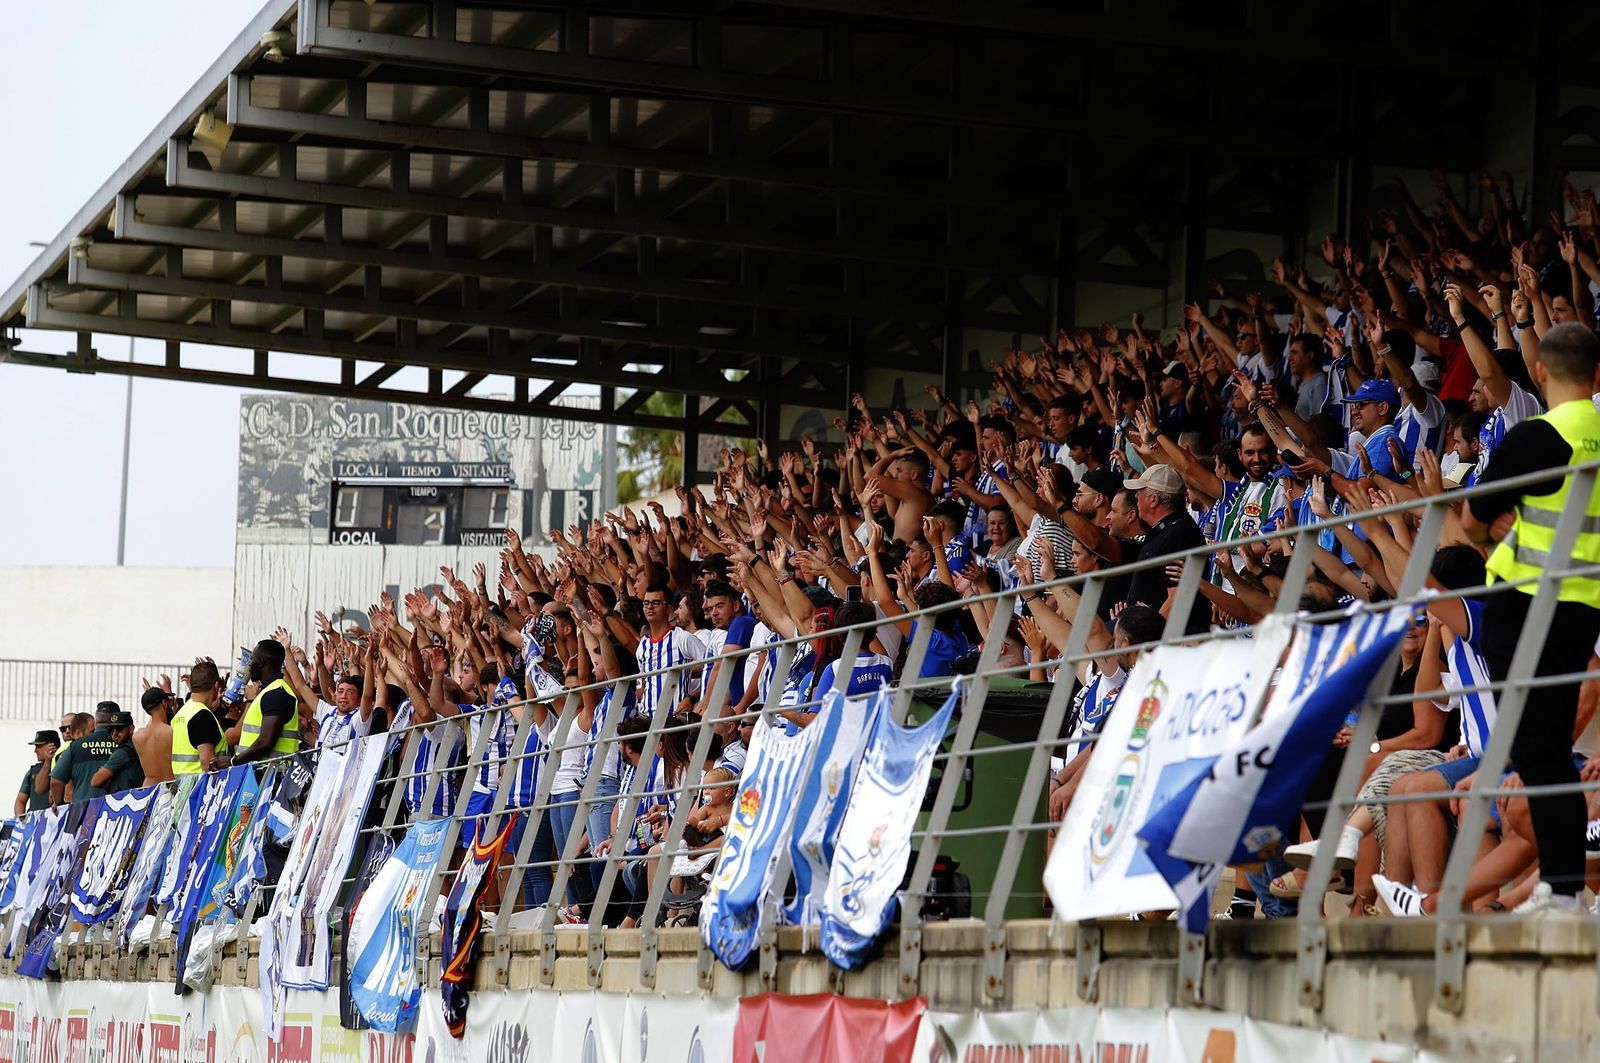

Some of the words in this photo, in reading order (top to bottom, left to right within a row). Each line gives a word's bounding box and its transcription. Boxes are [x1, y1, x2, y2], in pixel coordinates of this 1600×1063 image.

[329, 401, 382, 438] San
[388, 402, 481, 449] Roque
[484, 410, 521, 439] de
[339, 464, 383, 477] LOCAL
[400, 464, 441, 477] TIEMPO
[452, 464, 509, 478] VISITANTE
[410, 486, 438, 497] TIEMPO
[332, 531, 380, 545] LOCAL
[460, 532, 508, 546] VISITANTE
